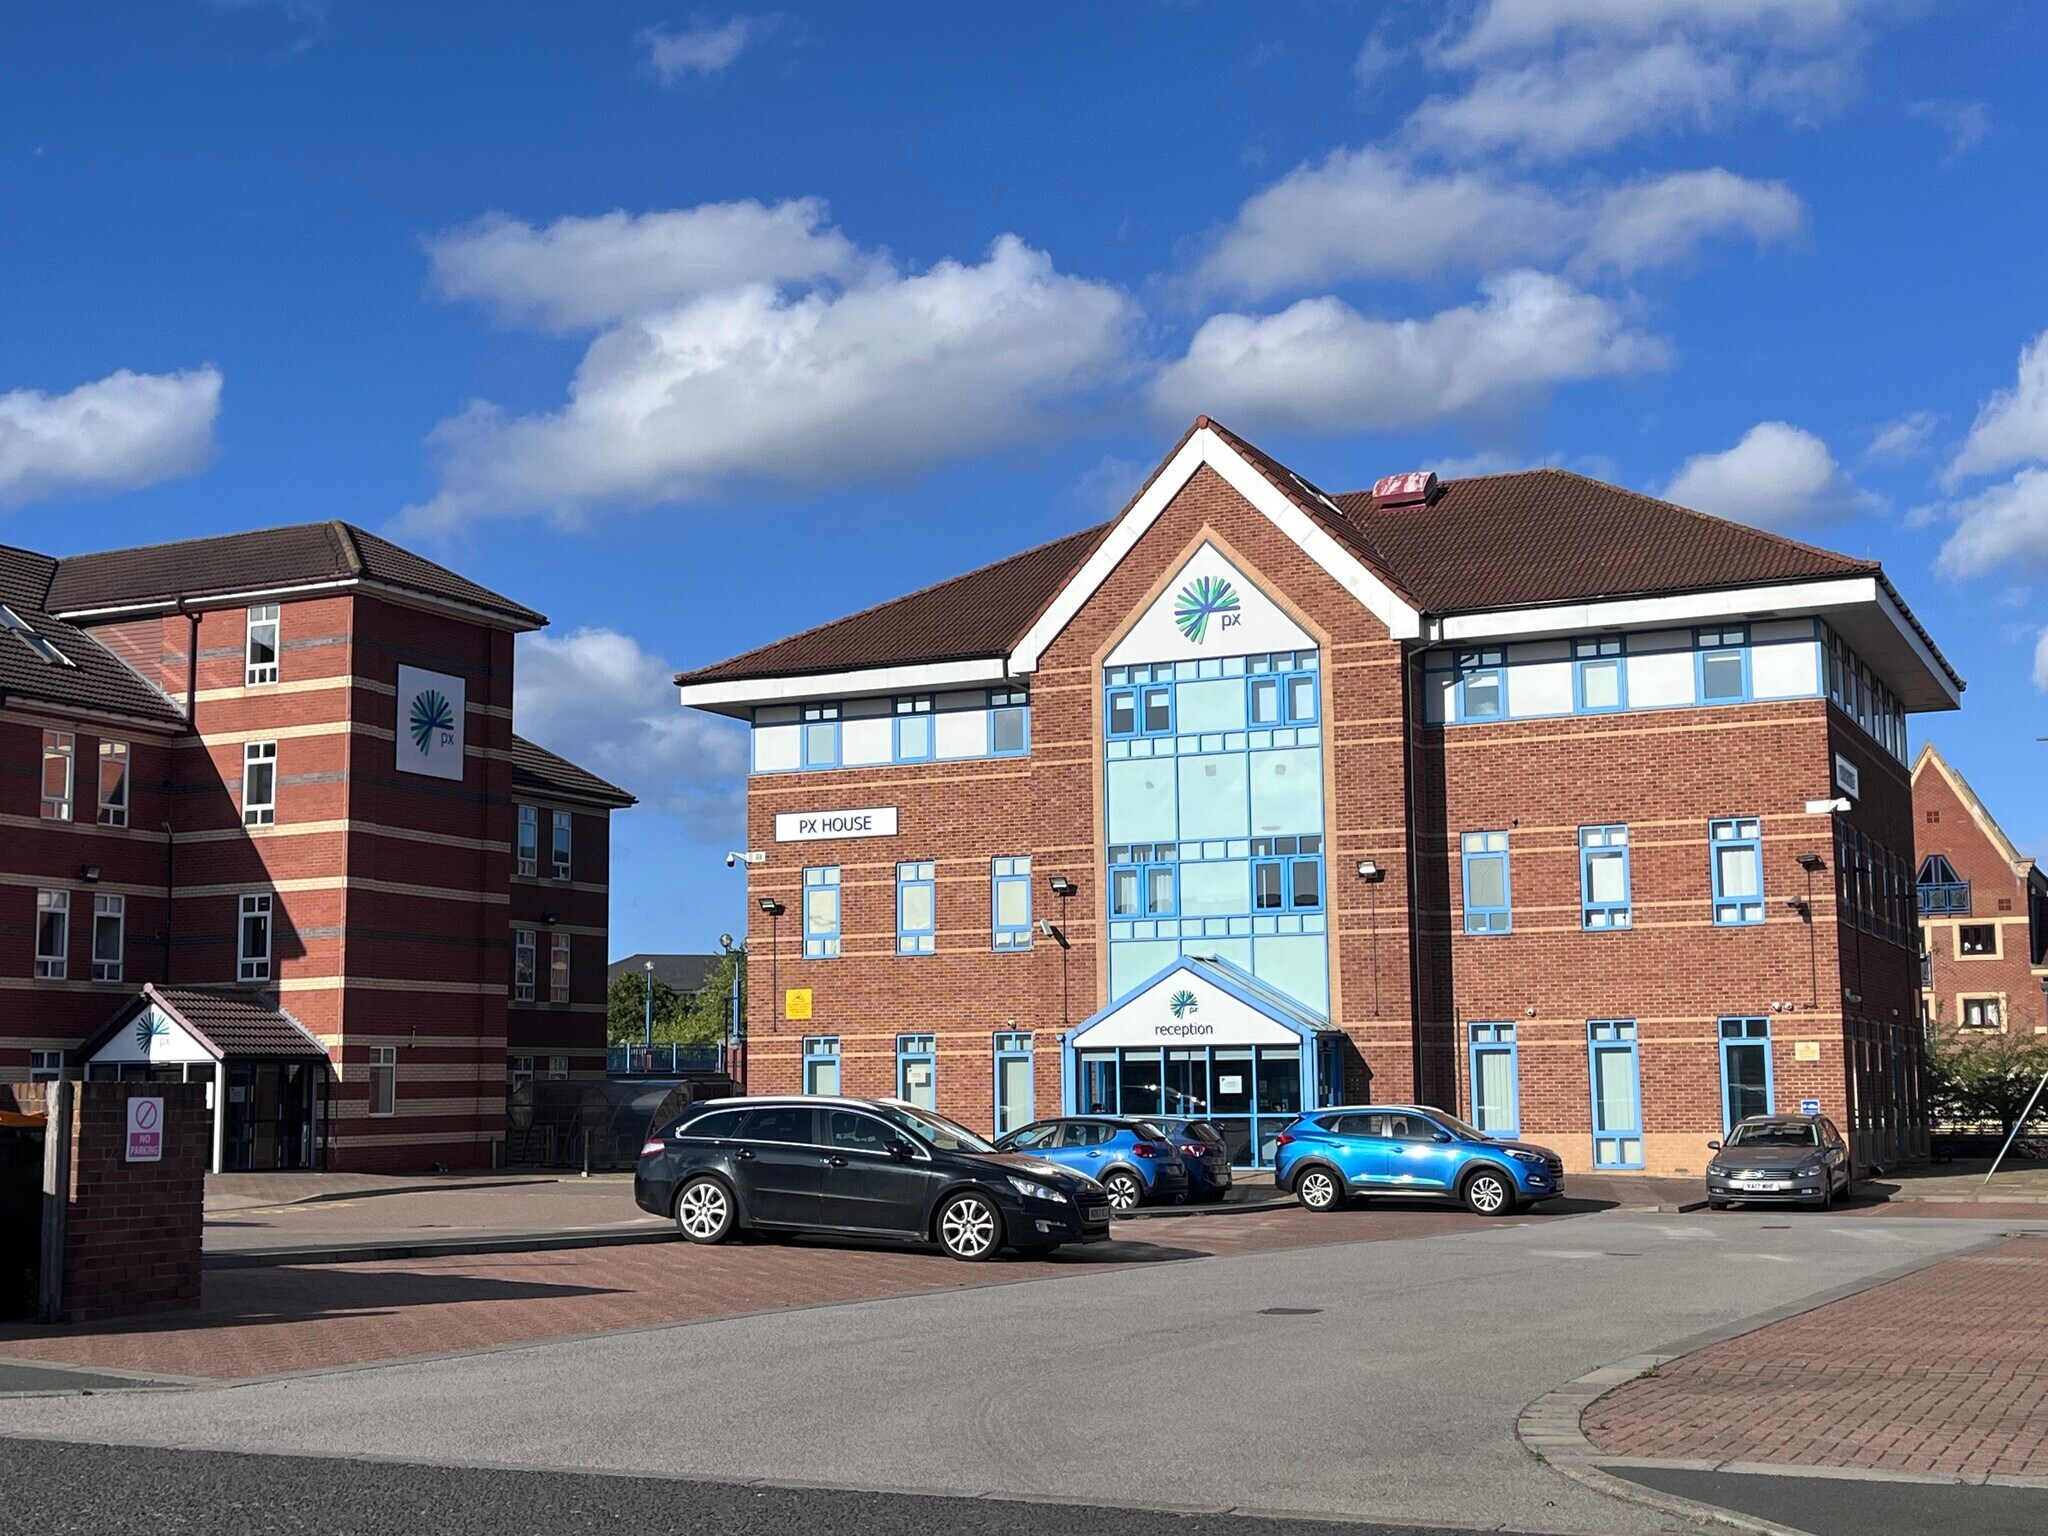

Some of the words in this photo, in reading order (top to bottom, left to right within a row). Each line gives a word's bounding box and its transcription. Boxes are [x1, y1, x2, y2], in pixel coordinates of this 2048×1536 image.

[1221, 613, 1242, 631] px
[440, 731, 455, 748] px
[799, 819, 818, 834] PX
[822, 815, 873, 832] HOUSE
[1189, 1006, 1199, 1014] px
[1154, 1022, 1214, 1038] reception
[139, 1134, 151, 1144] NO
[130, 1145, 159, 1155] PARKING
